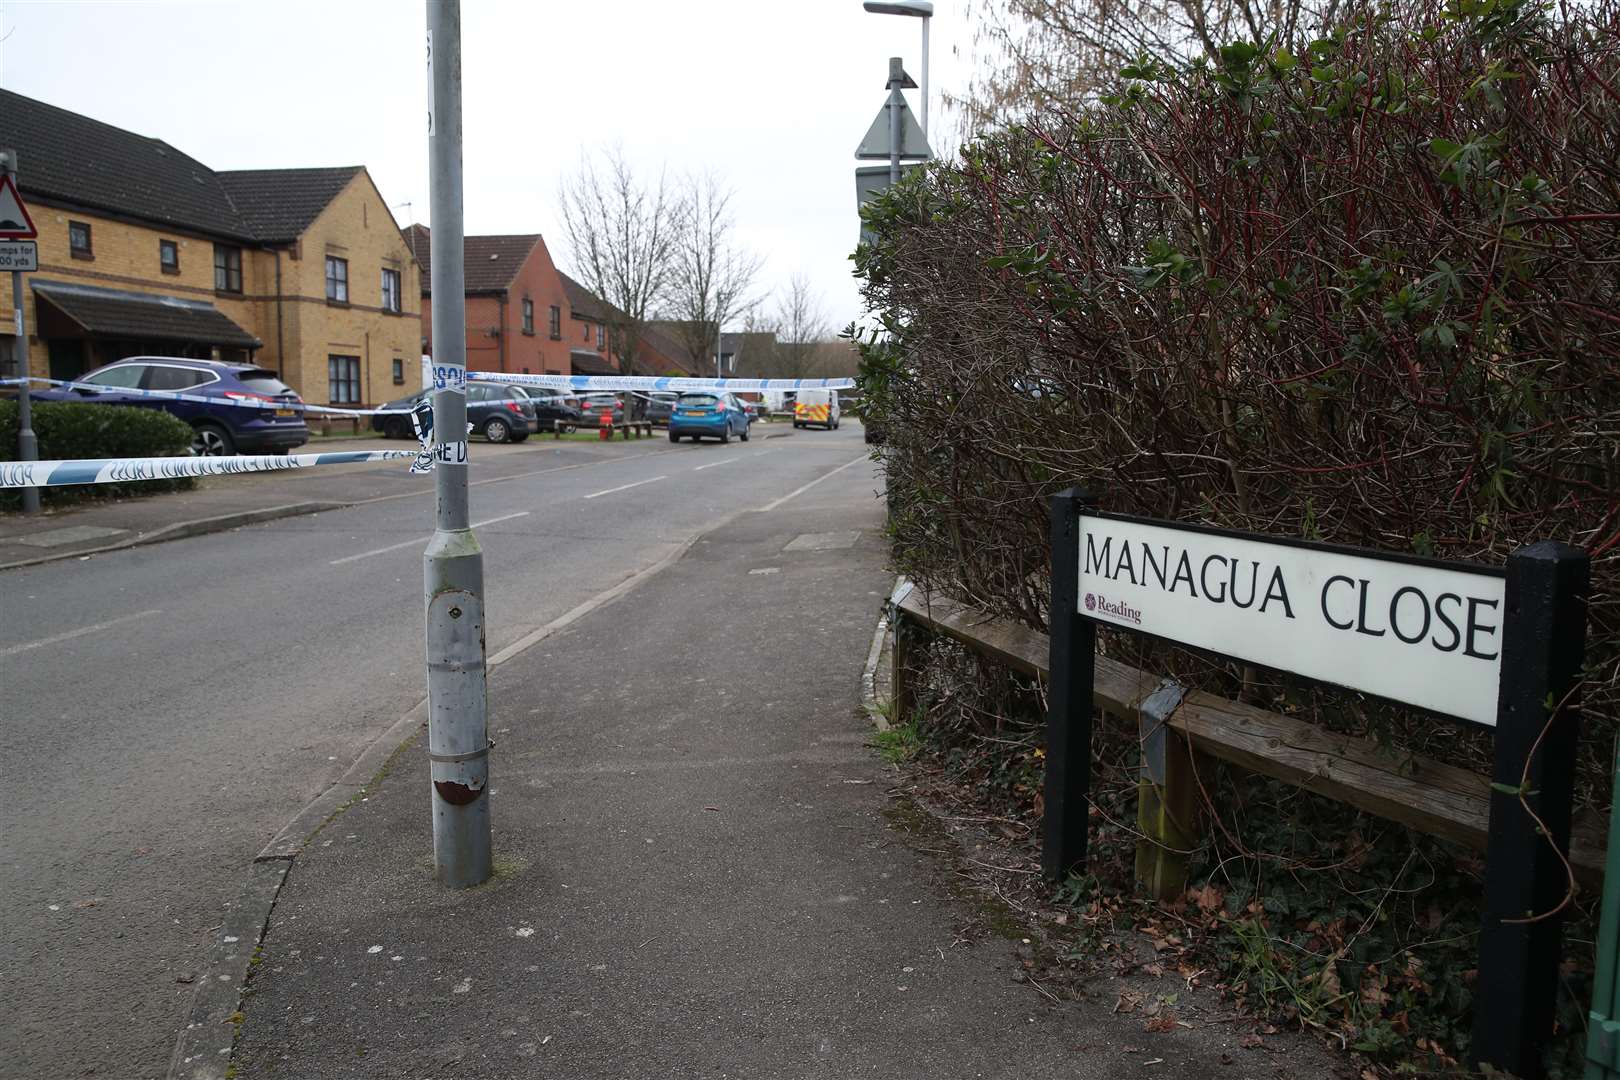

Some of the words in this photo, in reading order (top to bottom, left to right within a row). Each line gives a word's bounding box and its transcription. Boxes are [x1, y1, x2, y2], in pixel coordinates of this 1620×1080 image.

[0, 247, 17, 256] mps
[20, 245, 32, 254] for
[15, 257, 29, 267] yds
[1084, 533, 1296, 619] MANAGUA
[1320, 575, 1499, 661] CLOSE
[1097, 595, 1142, 625] Reading
